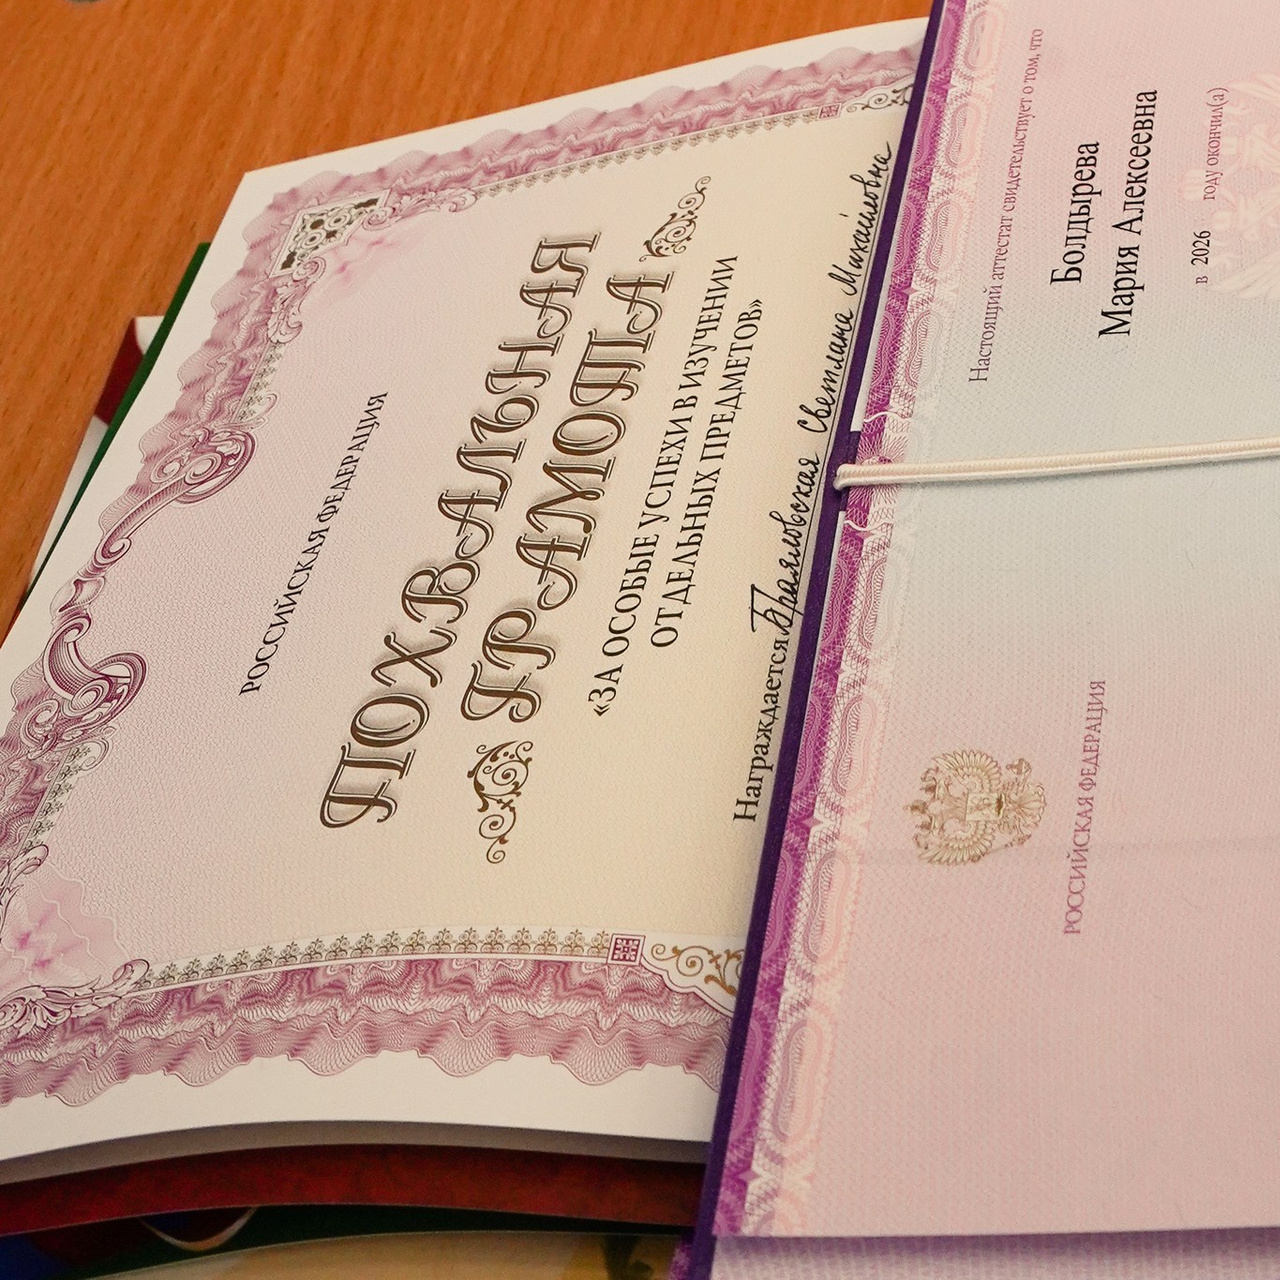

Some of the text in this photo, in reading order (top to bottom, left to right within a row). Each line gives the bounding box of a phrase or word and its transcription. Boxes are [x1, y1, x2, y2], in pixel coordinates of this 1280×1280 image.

[797, 308, 853, 433] Светлана
[828, 141, 892, 296] Михайловна
[968, 28, 1044, 382] Настоящий аттестат свидетельствует о том, что
[1049, 141, 1102, 285] Болдырева
[1098, 89, 1159, 338] Мария Алексеевна
[1191, 87, 1229, 284] в 2026 году окончил(а)
[238, 392, 388, 696] РОССИЙСКАЯ ФЕДЕРАЦИЯ
[318, 233, 598, 829] ПОХВАЛЬНАЯ
[460, 272, 673, 723] ГРАМОТА
[587, 255, 739, 717] «ЗА ОСОБЫЕ УСПЕХИ В ИЗУЧЕНИИ
[650, 298, 765, 649] ОТДЕЛЬНЫХ ПРЕДМЕТОВ»
[732, 635, 790, 822] Награждается
[1062, 678, 1109, 935] РОССИЙСКАЯ ФЕДЕРАЦИЯ
